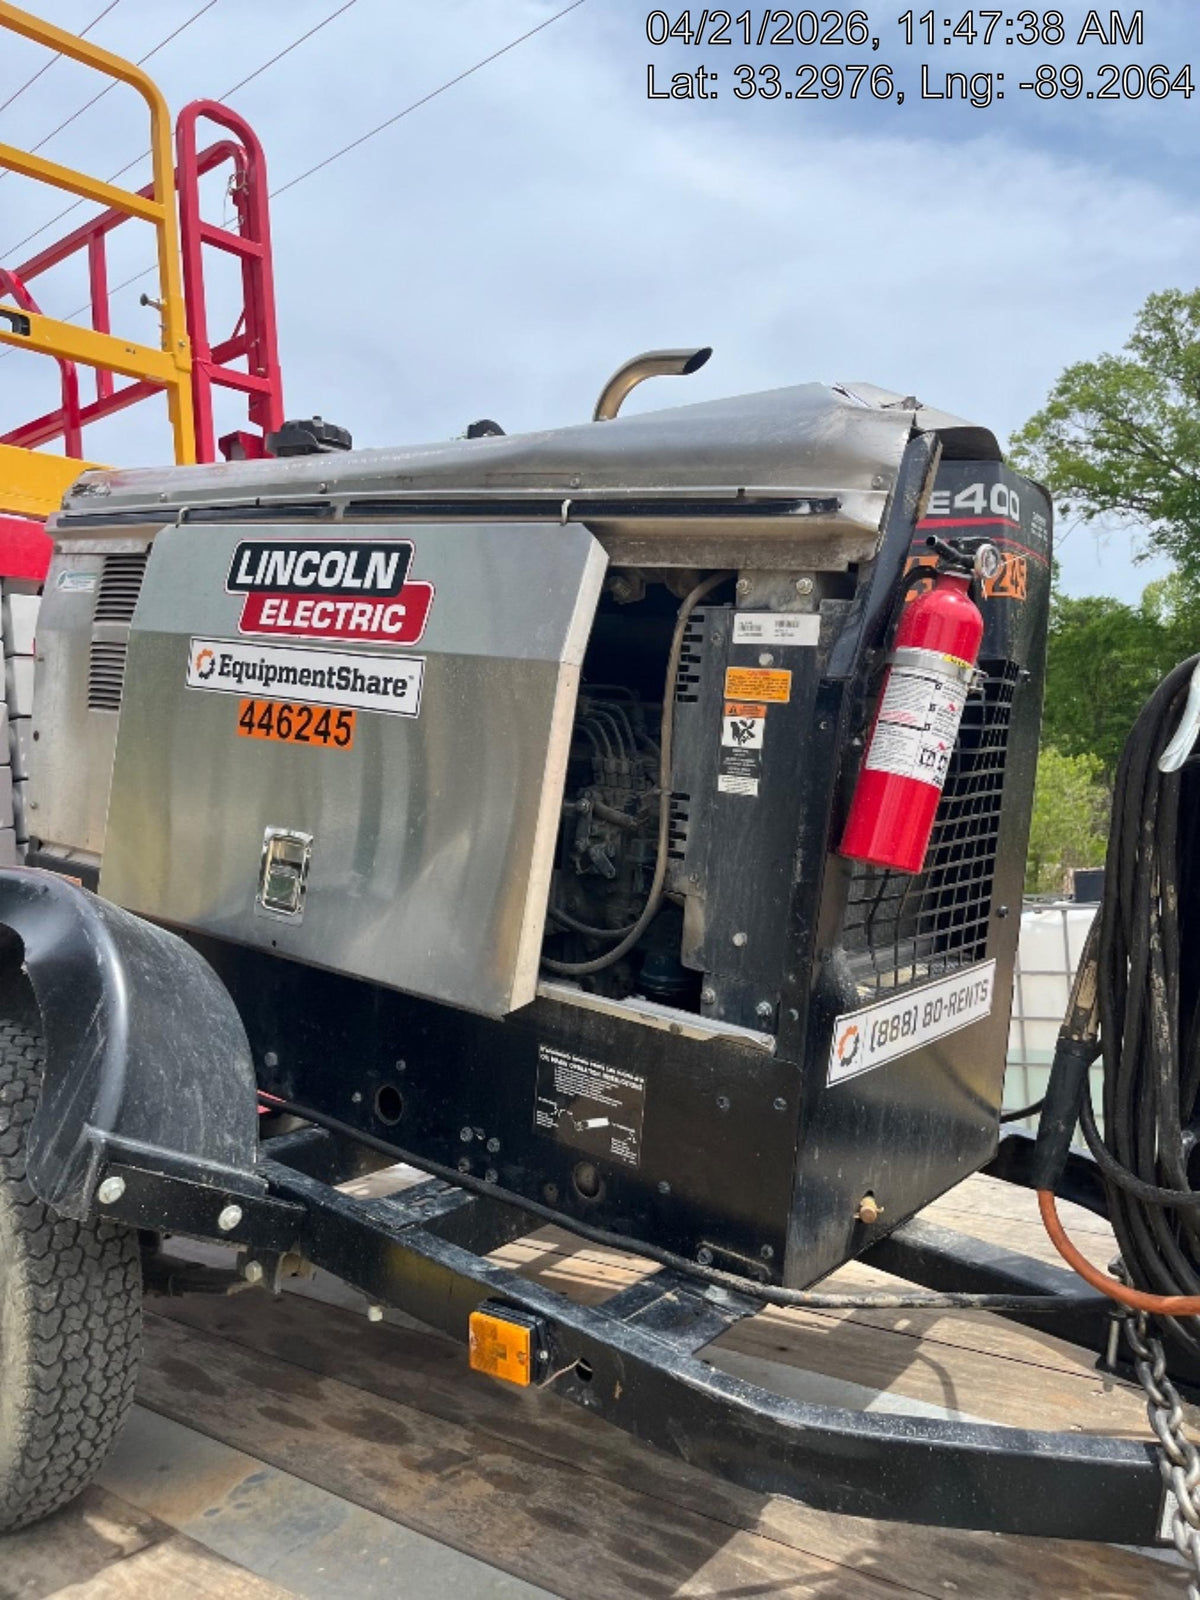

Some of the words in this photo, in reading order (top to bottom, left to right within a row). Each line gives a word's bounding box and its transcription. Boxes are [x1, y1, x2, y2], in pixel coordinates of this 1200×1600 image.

[236, 550, 401, 590] LINCOLN
[259, 599, 407, 633] ELECTRIC
[239, 700, 353, 747] 446245
[870, 1006, 919, 1053] (888)
[922, 979, 989, 1029] 80-RENTS
